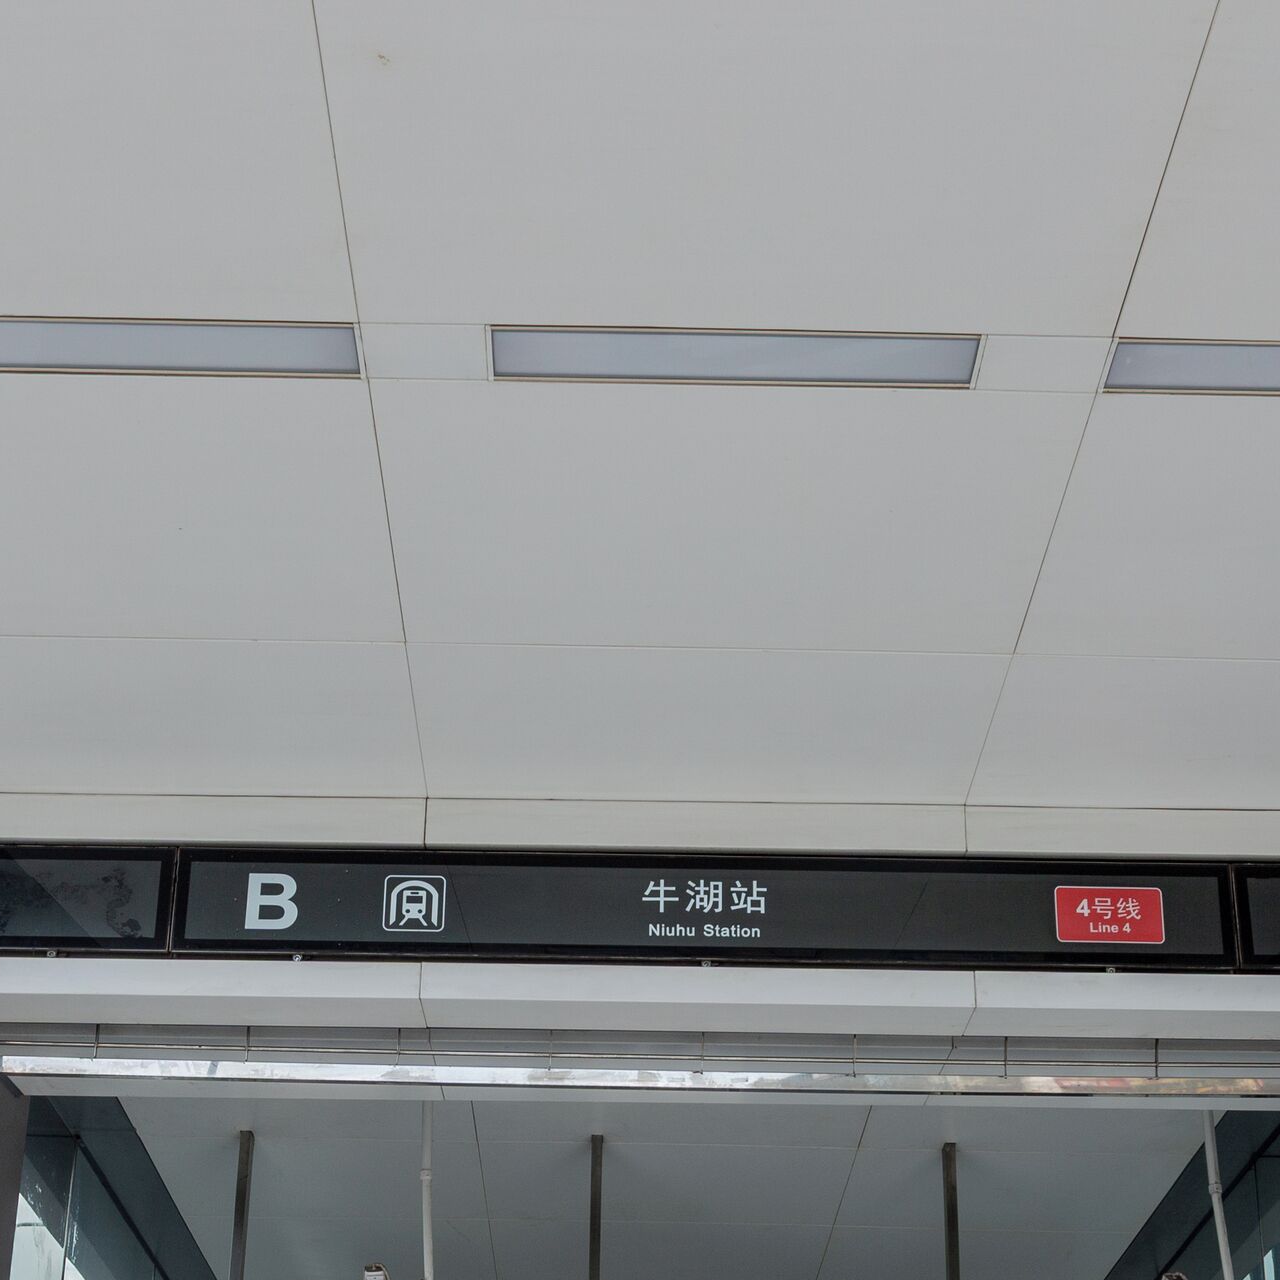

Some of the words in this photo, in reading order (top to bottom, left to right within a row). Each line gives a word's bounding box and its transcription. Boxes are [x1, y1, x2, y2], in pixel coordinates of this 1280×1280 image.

[244, 873, 299, 931] B
[642, 879, 767, 914] 牛湖站
[1075, 897, 1141, 920] 4号线
[648, 923, 695, 936] Niuhu
[703, 924, 761, 938] Station
[1089, 922, 1119, 933] Line
[1122, 923, 1131, 933] 4
